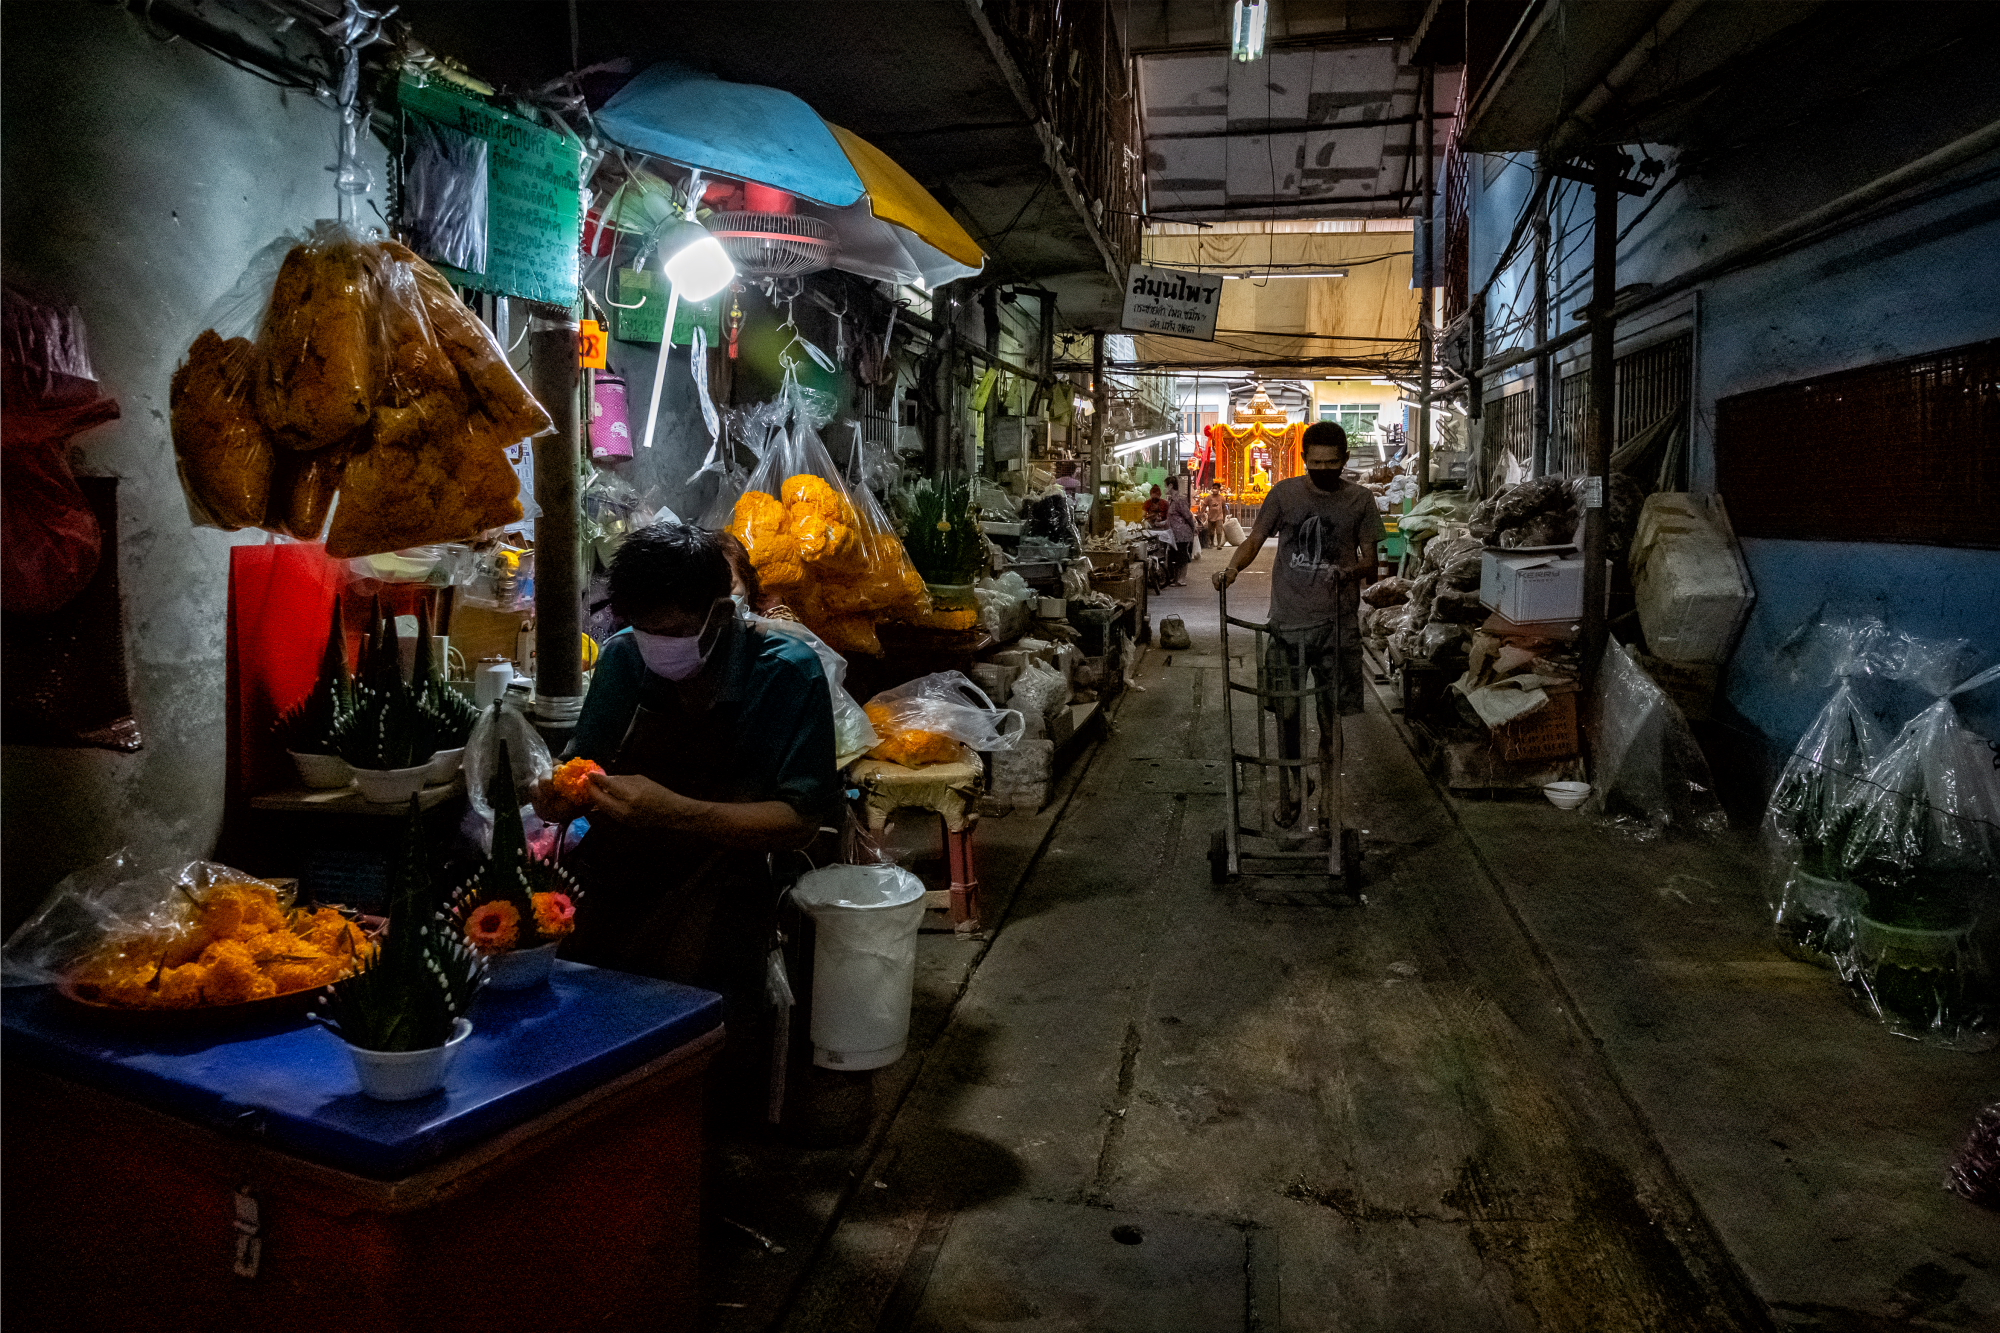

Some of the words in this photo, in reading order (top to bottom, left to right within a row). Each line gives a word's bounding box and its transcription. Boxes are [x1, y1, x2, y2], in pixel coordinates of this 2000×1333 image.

[1133, 274, 1218, 304] สมุนไพร
[1517, 571, 1560, 579] KERRY
